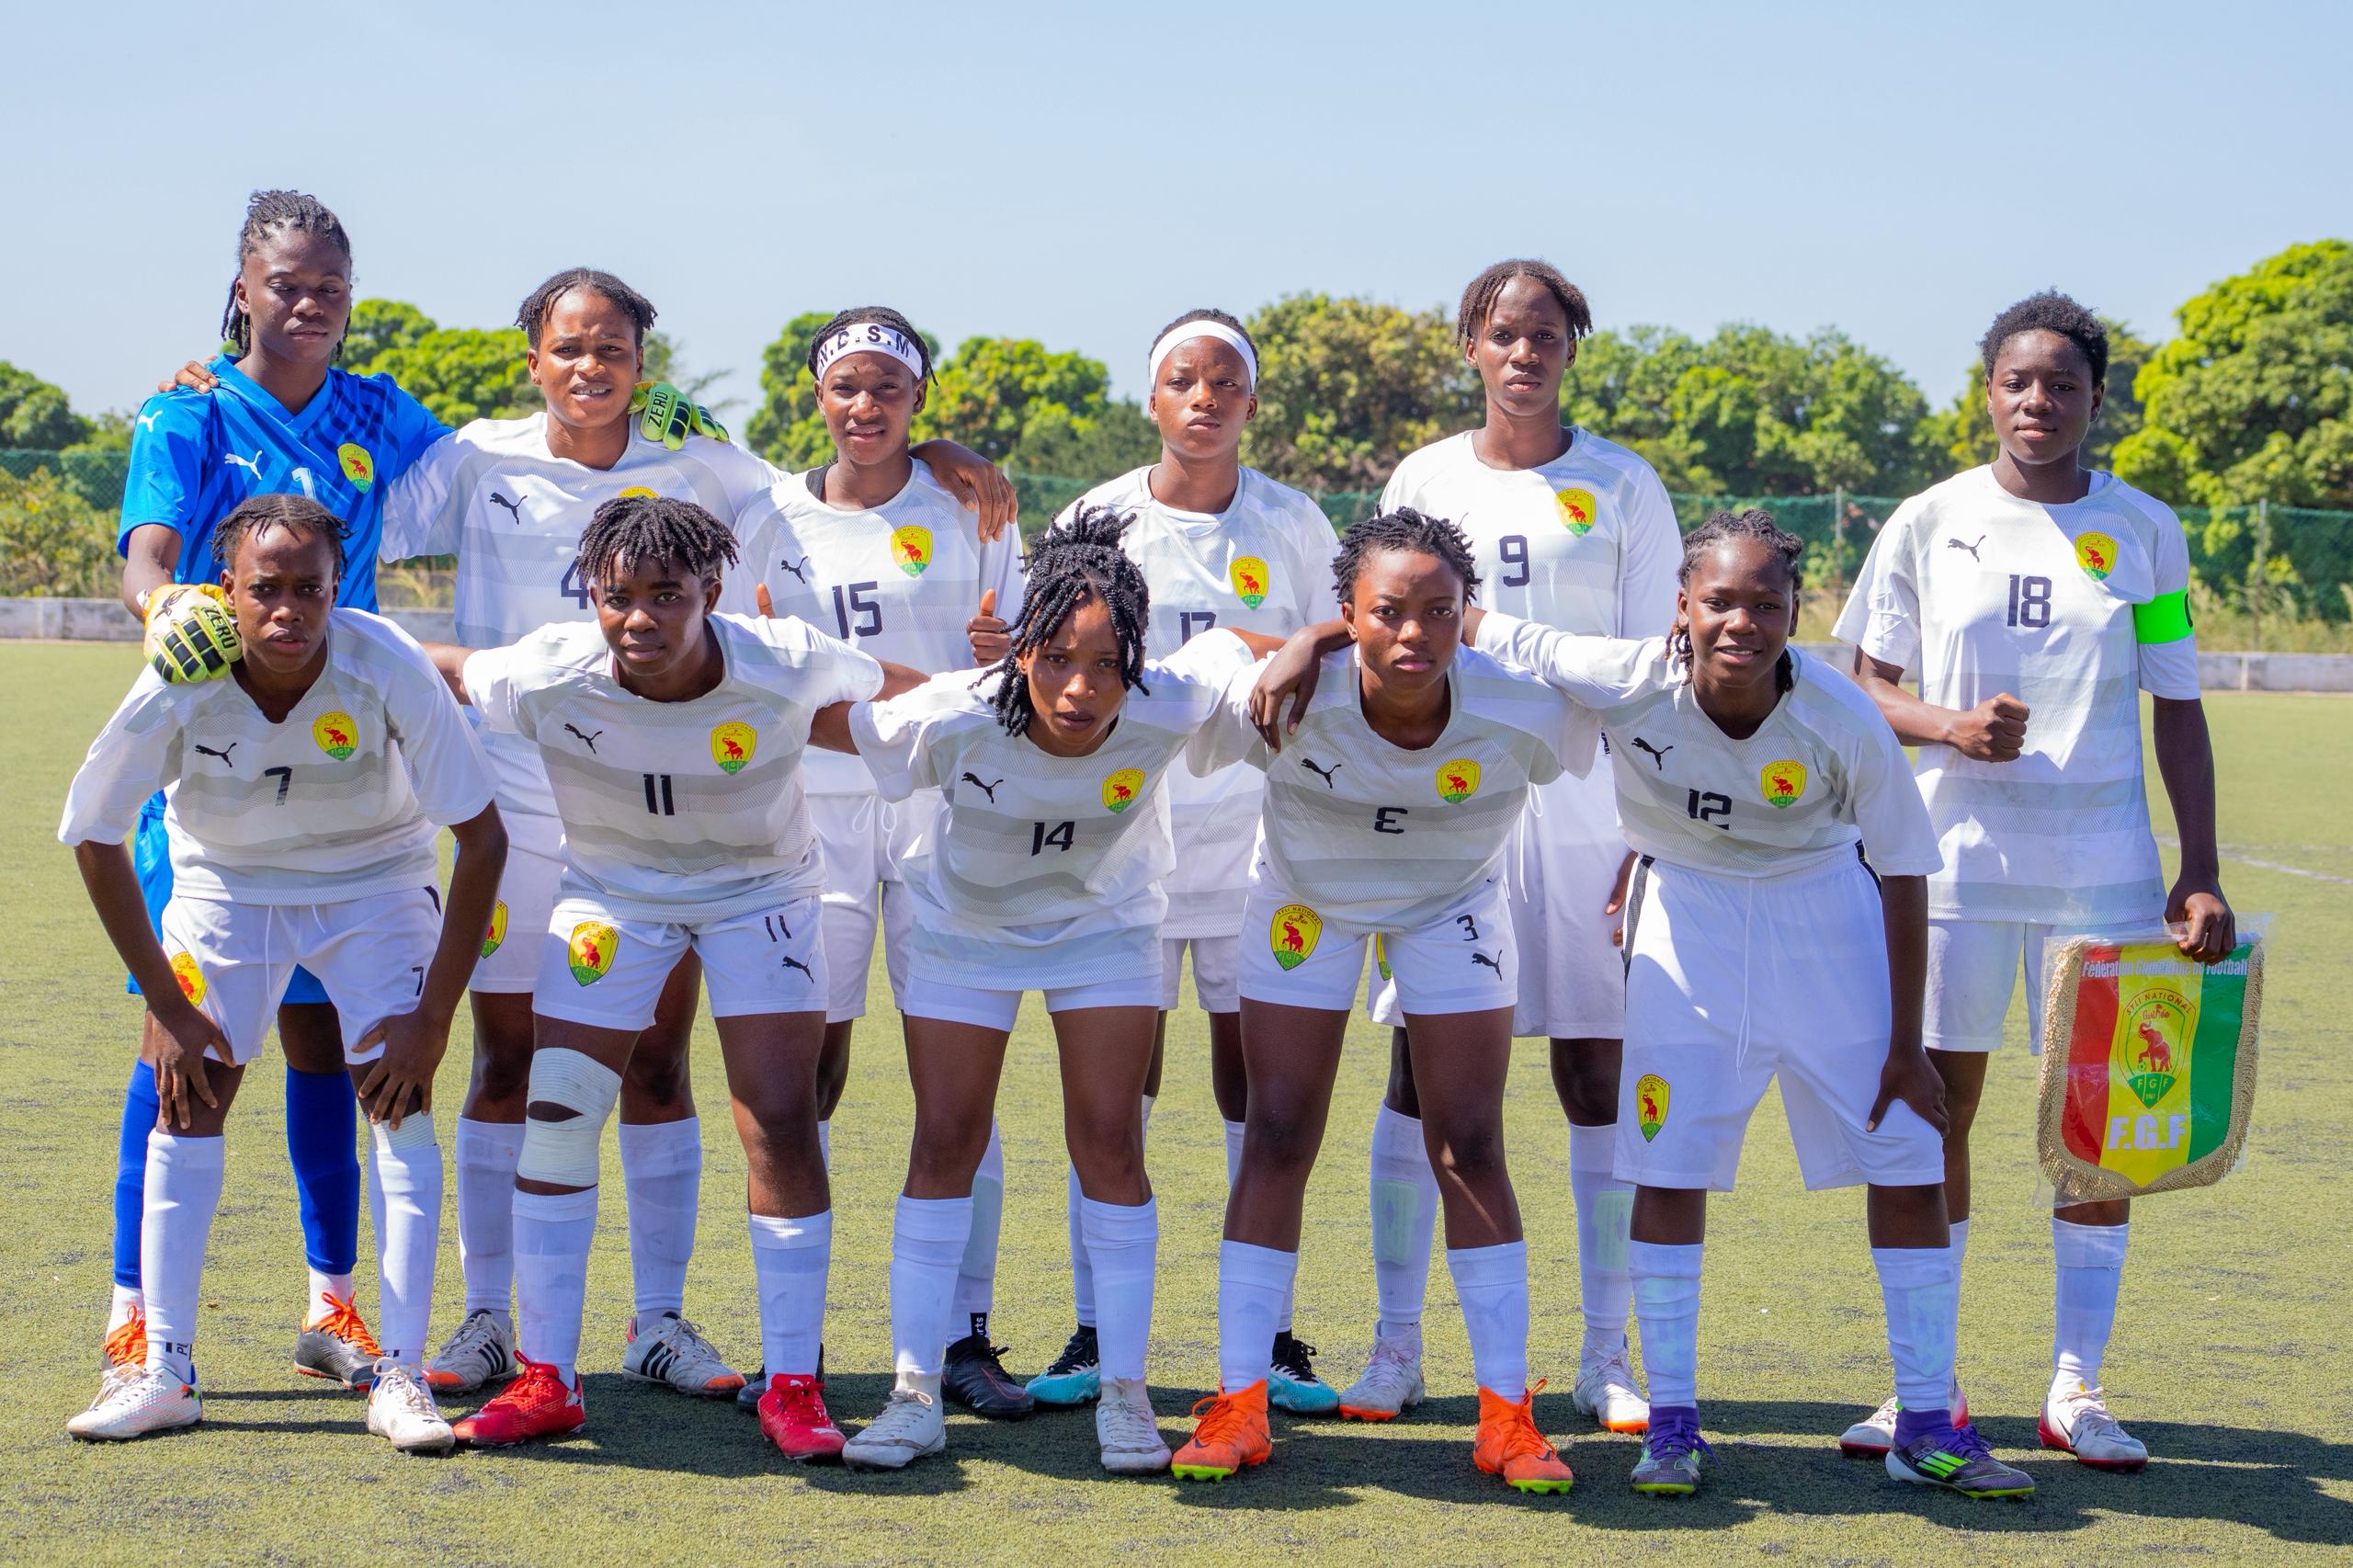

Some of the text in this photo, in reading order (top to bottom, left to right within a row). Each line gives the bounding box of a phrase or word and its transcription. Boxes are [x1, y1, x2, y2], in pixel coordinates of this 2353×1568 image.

[648, 392, 669, 428] ZERO
[1499, 535, 1530, 587] 9
[561, 556, 589, 609] 4
[2007, 574, 2052, 628] 18
[201, 606, 238, 649] ZERO
[832, 581, 882, 640] 15
[264, 766, 292, 806] 7
[643, 774, 675, 816] 11
[1688, 788, 1733, 831] 12
[1031, 821, 1075, 857] 14
[765, 915, 792, 942] 11
[1456, 914, 1479, 941] 3
[412, 966, 424, 996] 7
[2126, 992, 2191, 1015] SYLI NATIONAL
[2108, 1114, 2186, 1151] F.G.F
[974, 1316, 984, 1335] rts
